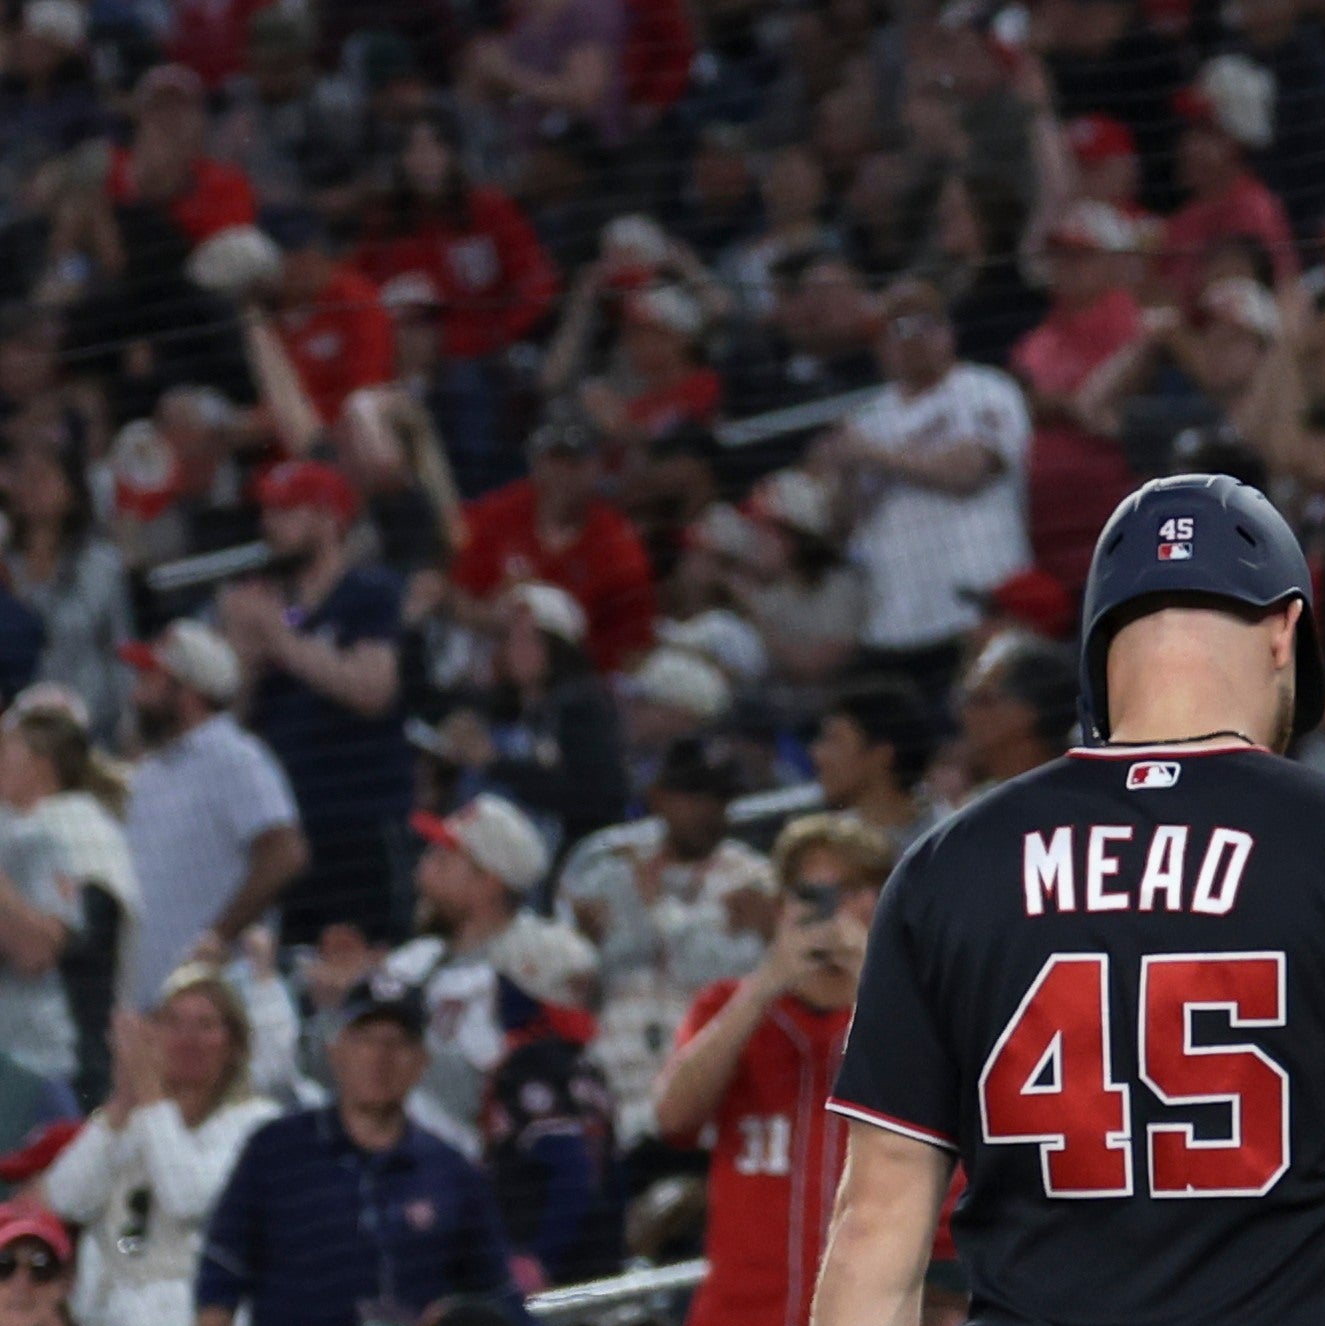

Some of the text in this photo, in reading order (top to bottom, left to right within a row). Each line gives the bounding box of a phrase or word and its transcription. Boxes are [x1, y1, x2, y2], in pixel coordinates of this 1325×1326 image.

[1158, 518, 1194, 540] 45
[1023, 824, 1255, 917] MEAD
[978, 951, 1291, 1199] 45
